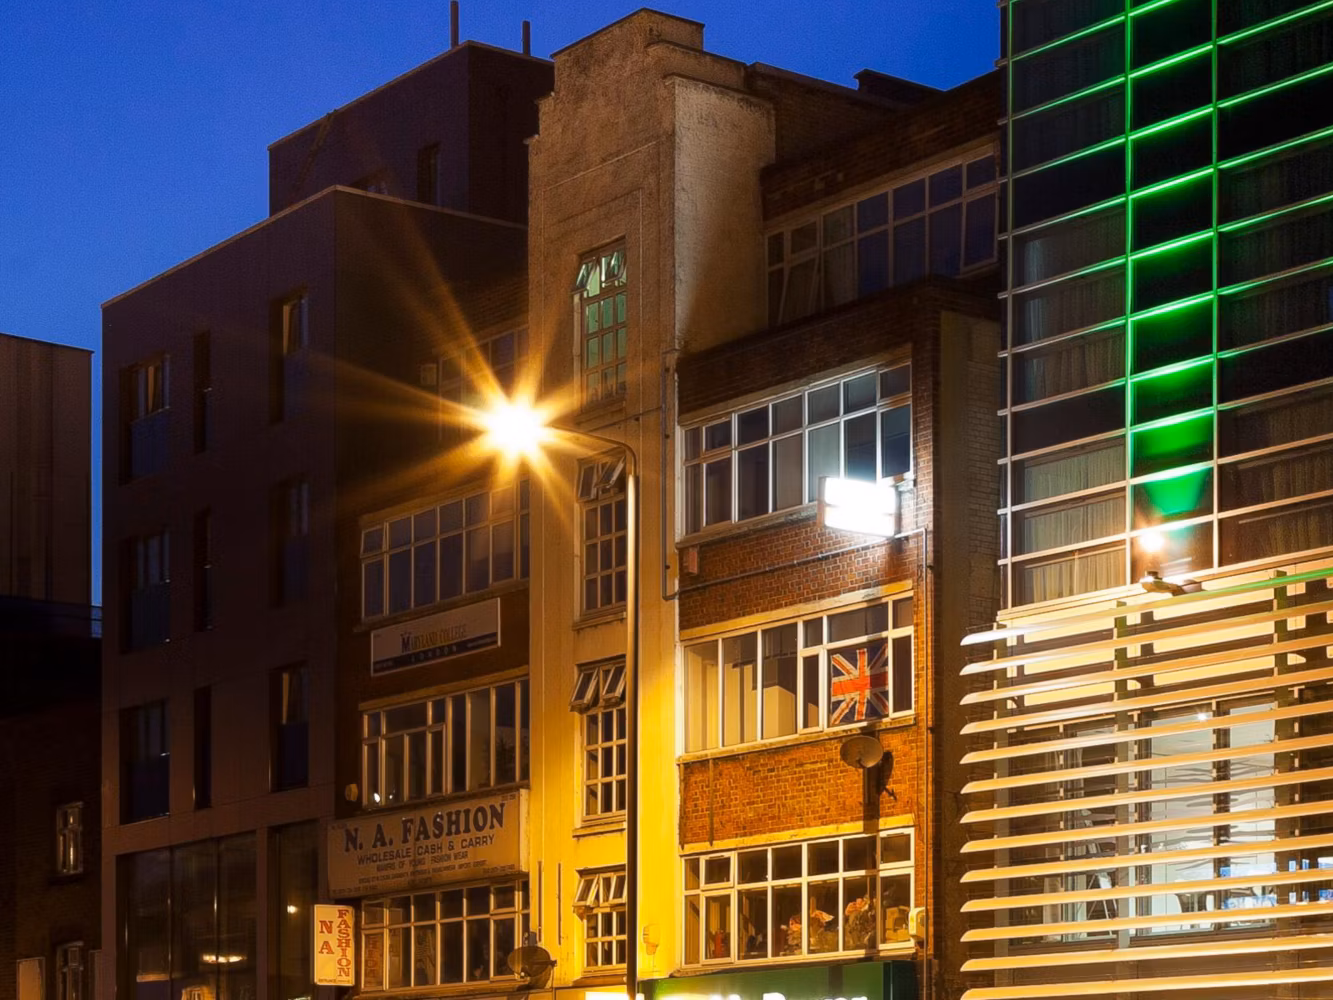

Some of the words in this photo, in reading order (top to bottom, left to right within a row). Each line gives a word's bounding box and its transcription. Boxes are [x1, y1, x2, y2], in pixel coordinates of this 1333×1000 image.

[372, 823, 394, 849] A.
[402, 803, 505, 844] FASHION
[357, 847, 411, 865] WHOLESALE
[417, 841, 443, 856] CASH
[448, 841, 455, 851] &
[460, 834, 495, 849] CARRY
[336, 909, 351, 977] FASHION
